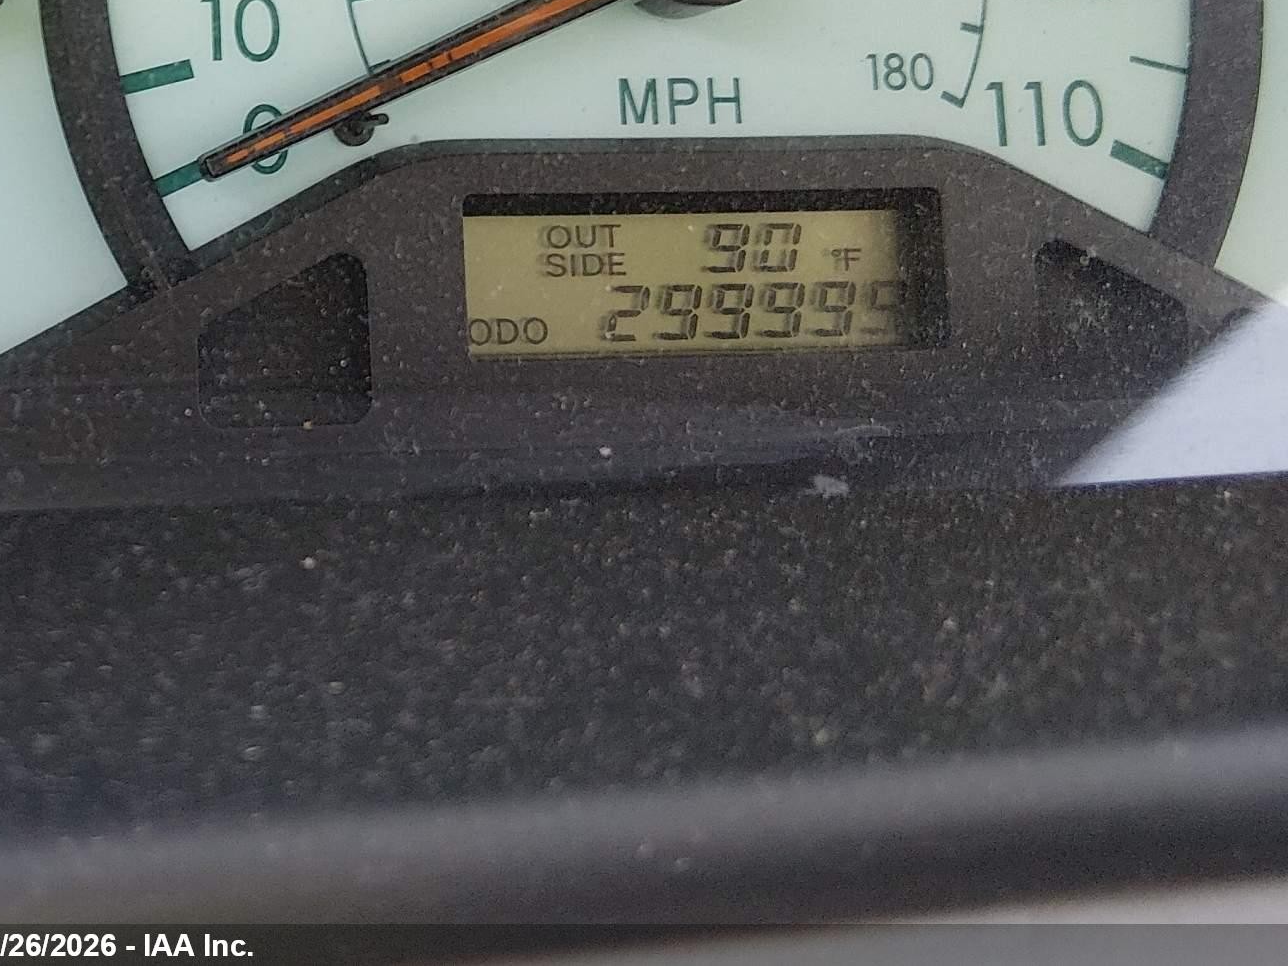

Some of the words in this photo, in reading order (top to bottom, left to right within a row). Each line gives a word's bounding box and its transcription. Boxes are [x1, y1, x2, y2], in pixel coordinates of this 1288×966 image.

[865, 52, 935, 92] 180
[617, 77, 744, 126] MPH
[985, 79, 1106, 148] 110
[546, 223, 622, 250] OUT
[704, 222, 803, 273] 90
[545, 252, 627, 278] SIDE
[468, 317, 549, 346] ODO
